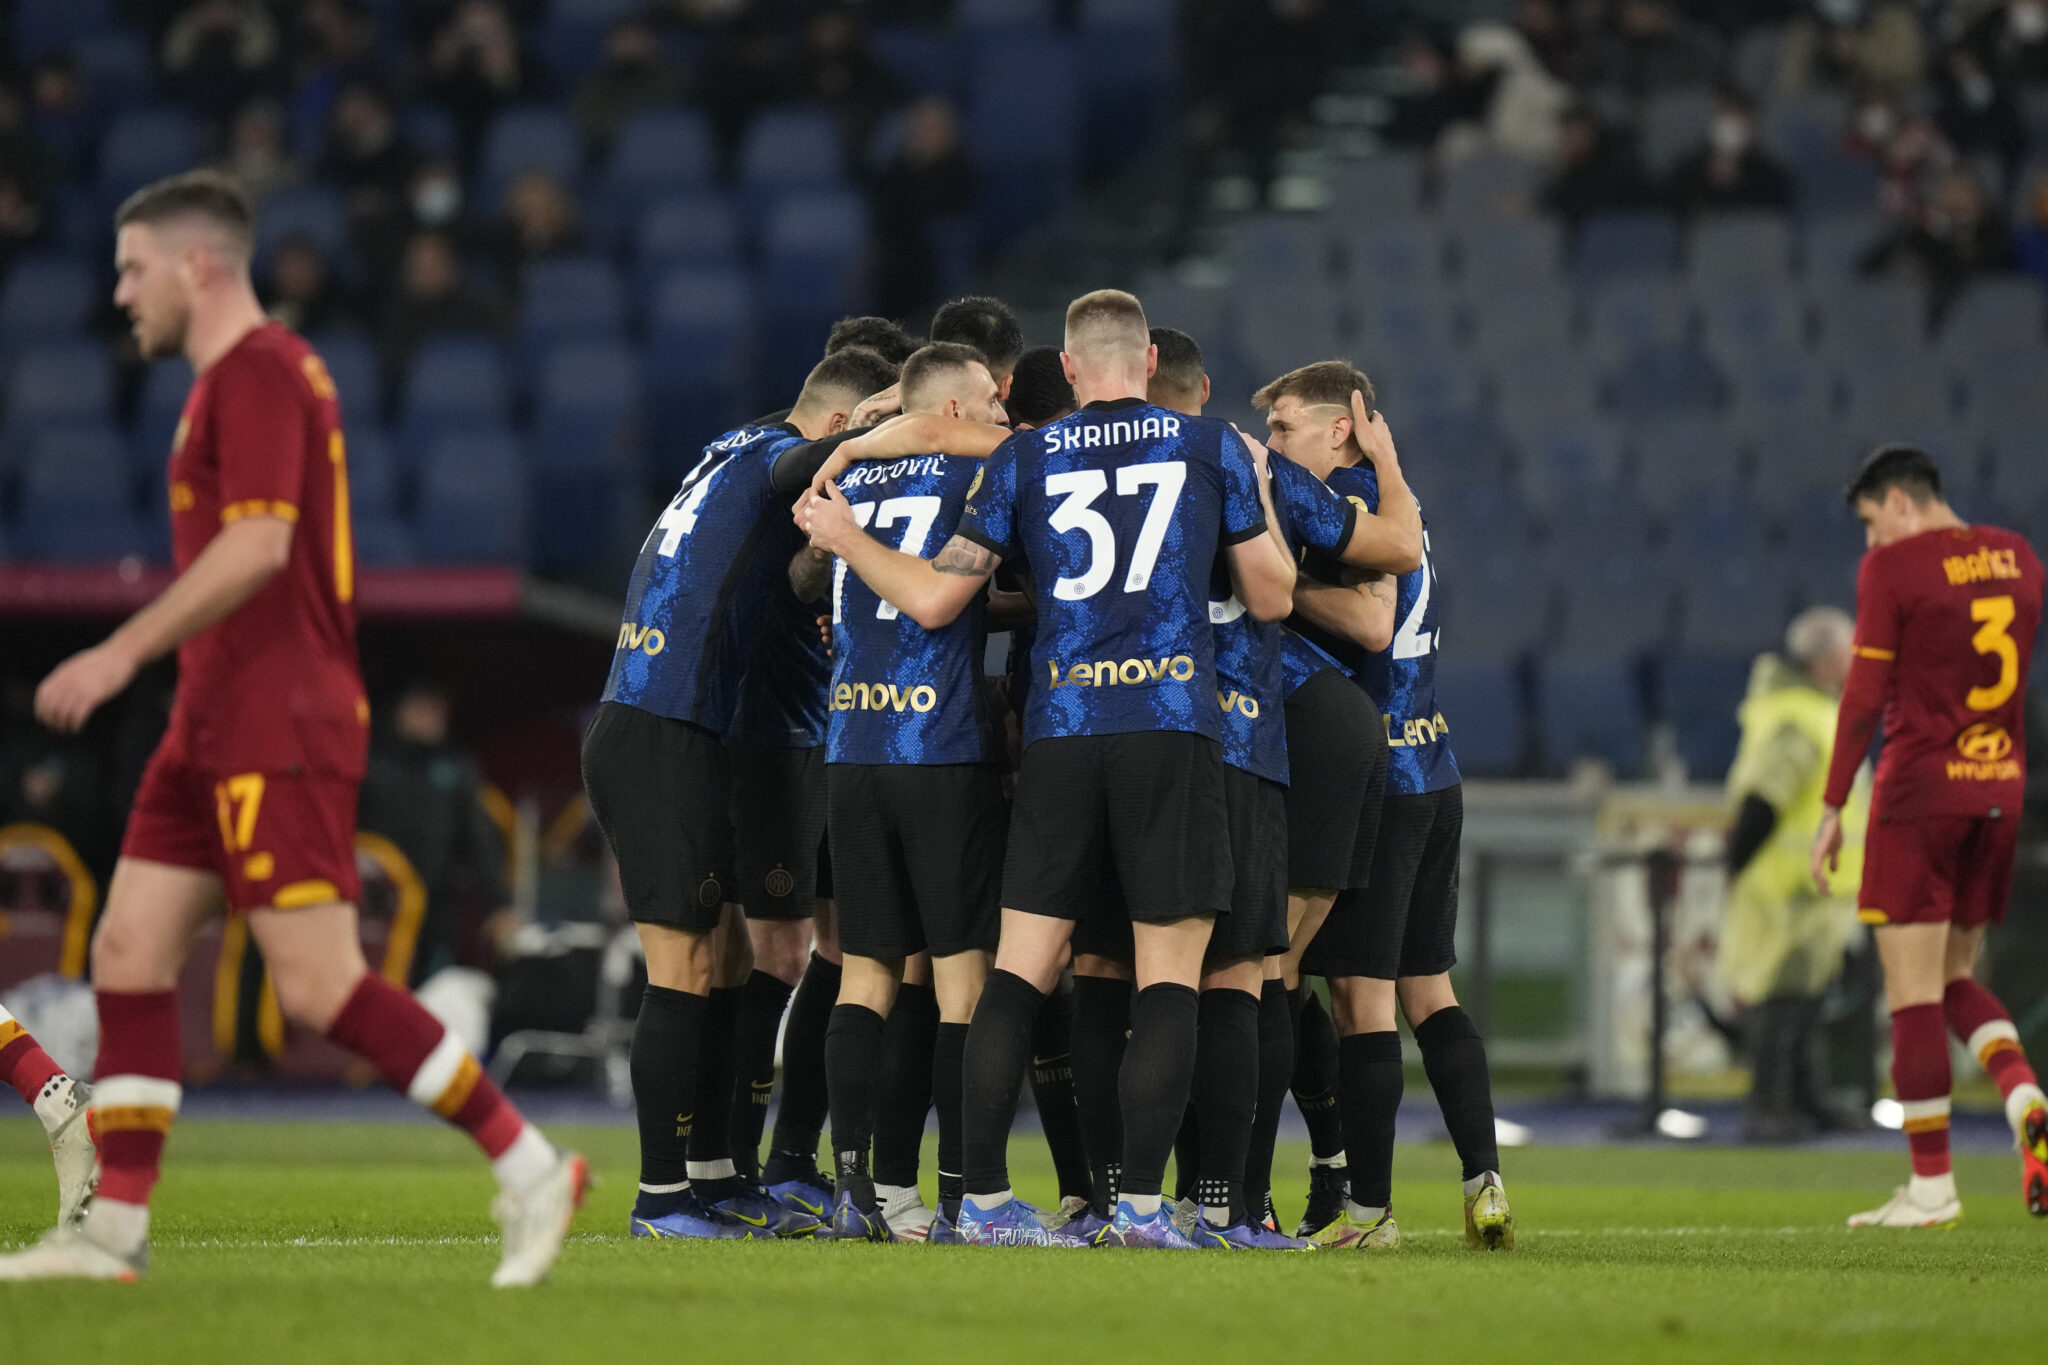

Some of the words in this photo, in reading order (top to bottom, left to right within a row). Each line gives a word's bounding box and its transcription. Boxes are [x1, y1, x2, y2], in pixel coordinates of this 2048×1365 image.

[1044, 416, 1180, 454] ŠKRINIAR
[1046, 461, 1187, 601] 37
[1048, 655, 1195, 690] Lenovo
[1966, 595, 2019, 712] 3
[215, 774, 264, 851] 17
